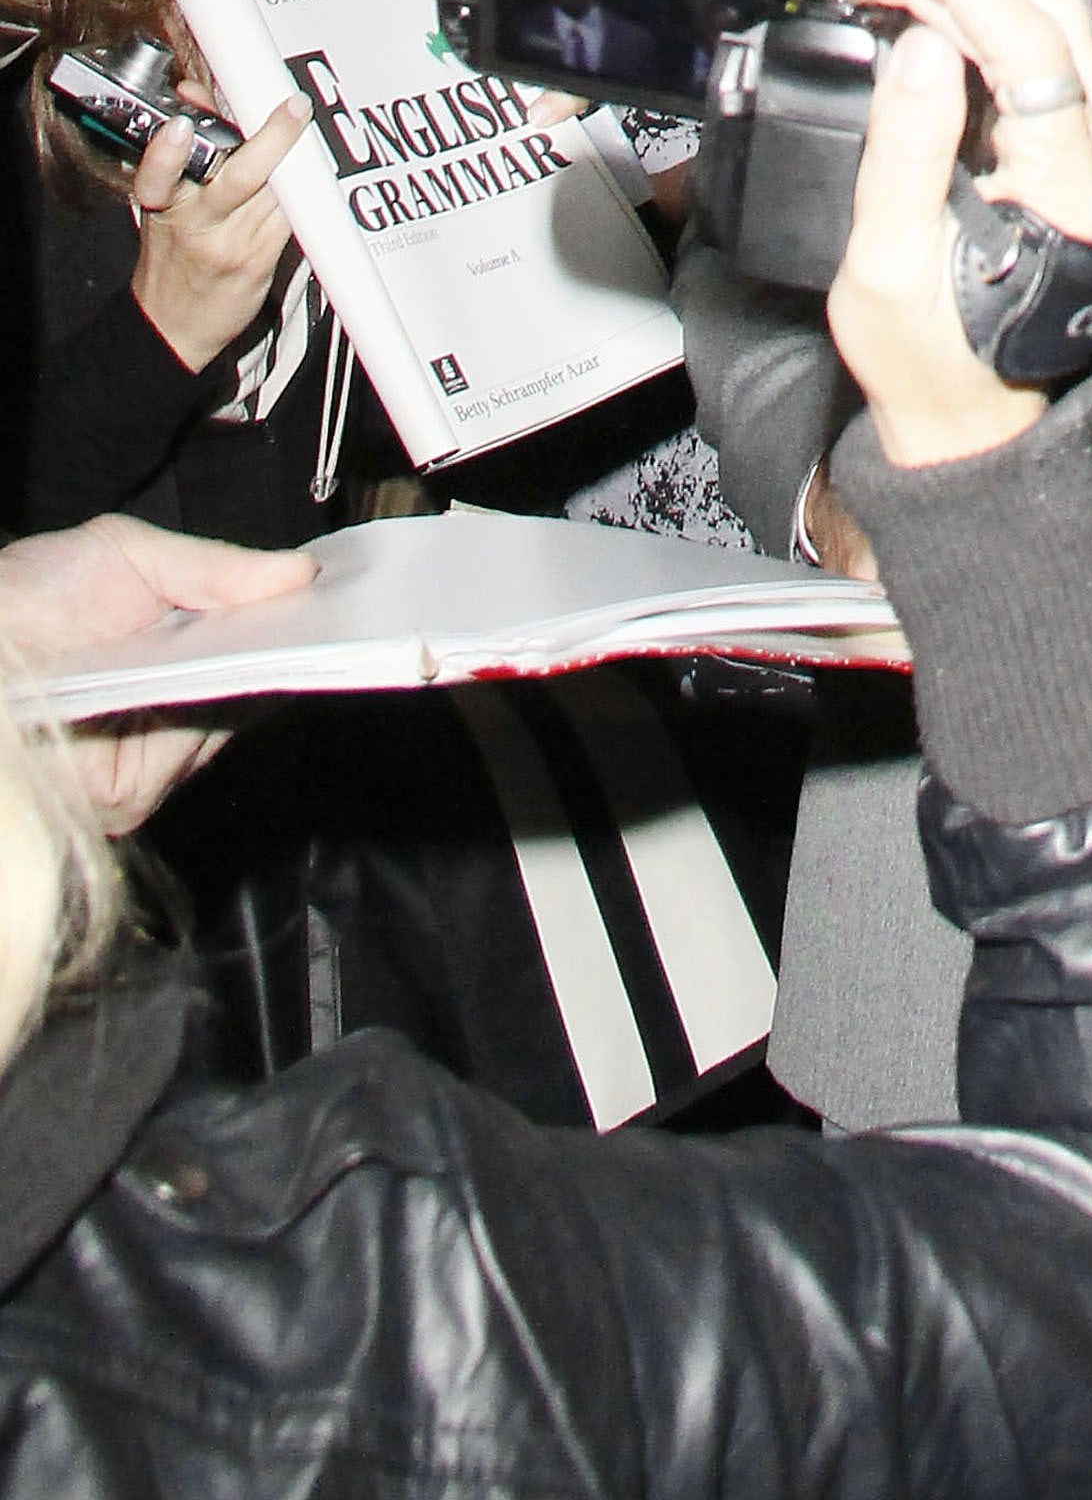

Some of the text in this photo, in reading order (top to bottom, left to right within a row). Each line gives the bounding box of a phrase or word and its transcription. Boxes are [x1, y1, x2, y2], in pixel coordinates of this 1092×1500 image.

[284, 50, 529, 179] ENGLISH
[350, 132, 573, 232] GRAMMAR
[466, 253, 510, 276] Volume
[454, 401, 491, 422] Betty
[489, 370, 566, 409] Schrampfer
[565, 355, 600, 379] Azar
